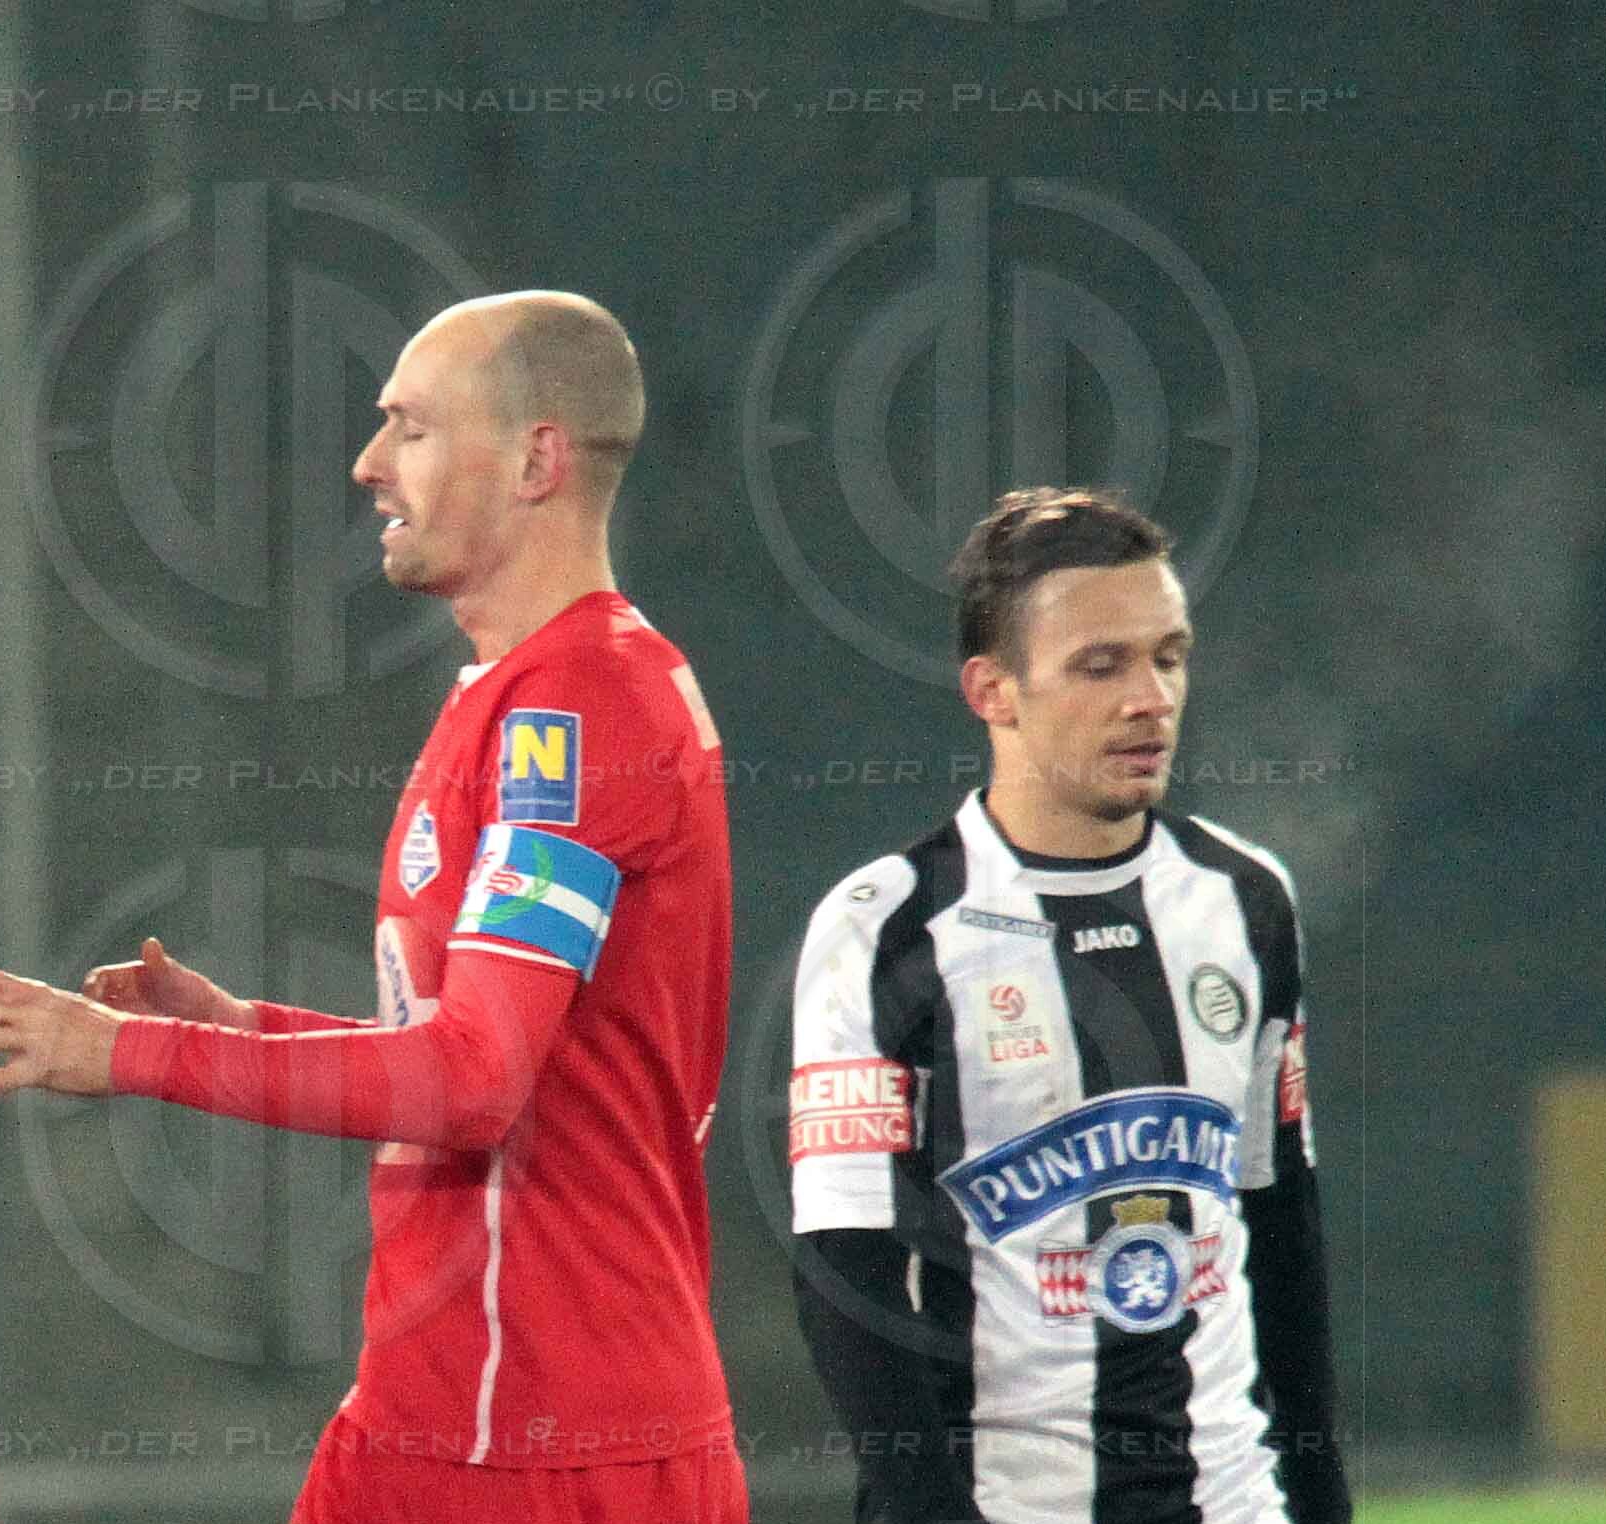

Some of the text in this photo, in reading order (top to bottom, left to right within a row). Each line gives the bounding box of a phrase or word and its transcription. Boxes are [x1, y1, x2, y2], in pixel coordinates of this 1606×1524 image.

[509, 723, 567, 782] N
[1073, 924, 1140, 954] JAKO
[989, 1038, 1050, 1064] LIGA
[789, 1066, 906, 1113] LEINE
